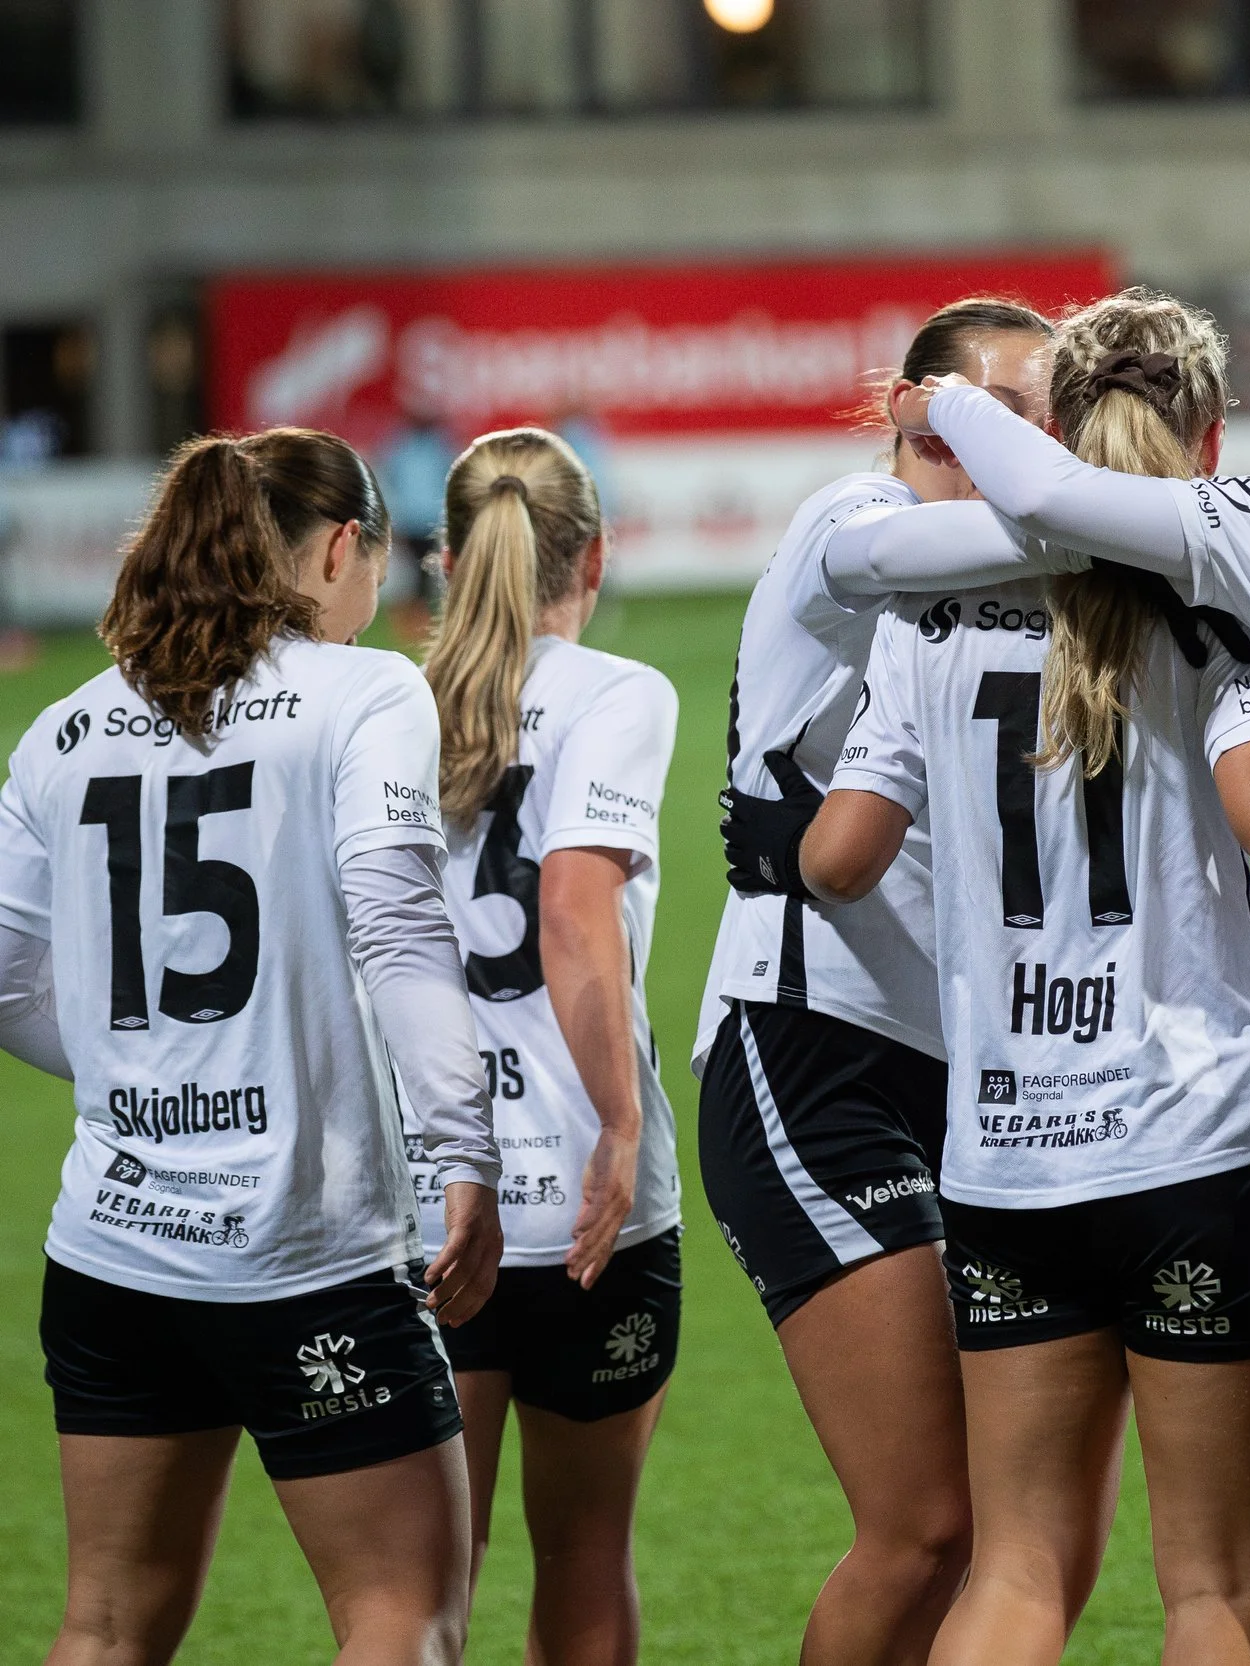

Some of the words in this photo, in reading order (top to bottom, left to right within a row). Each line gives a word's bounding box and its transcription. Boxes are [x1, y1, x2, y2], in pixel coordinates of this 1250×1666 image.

[1191, 483, 1221, 529] Sogn
[972, 671, 1133, 930] 11
[79, 760, 260, 1031] 15
[1011, 961, 1117, 1044] Høgi
[1022, 1067, 1131, 1088] FAGFORBUNDET
[109, 1082, 268, 1144] Skjølberg
[1022, 1090, 1064, 1102] Sogndal
[979, 1124, 1096, 1148] KREFTTRÅKK
[147, 1168, 261, 1189] FAGFORBUNDET
[89, 1208, 213, 1245] KREFTTRÅKK
[970, 1298, 1049, 1323] mesta
[1145, 1314, 1231, 1336] mesta
[591, 1352, 661, 1384] mesta
[301, 1385, 392, 1421] mesta
